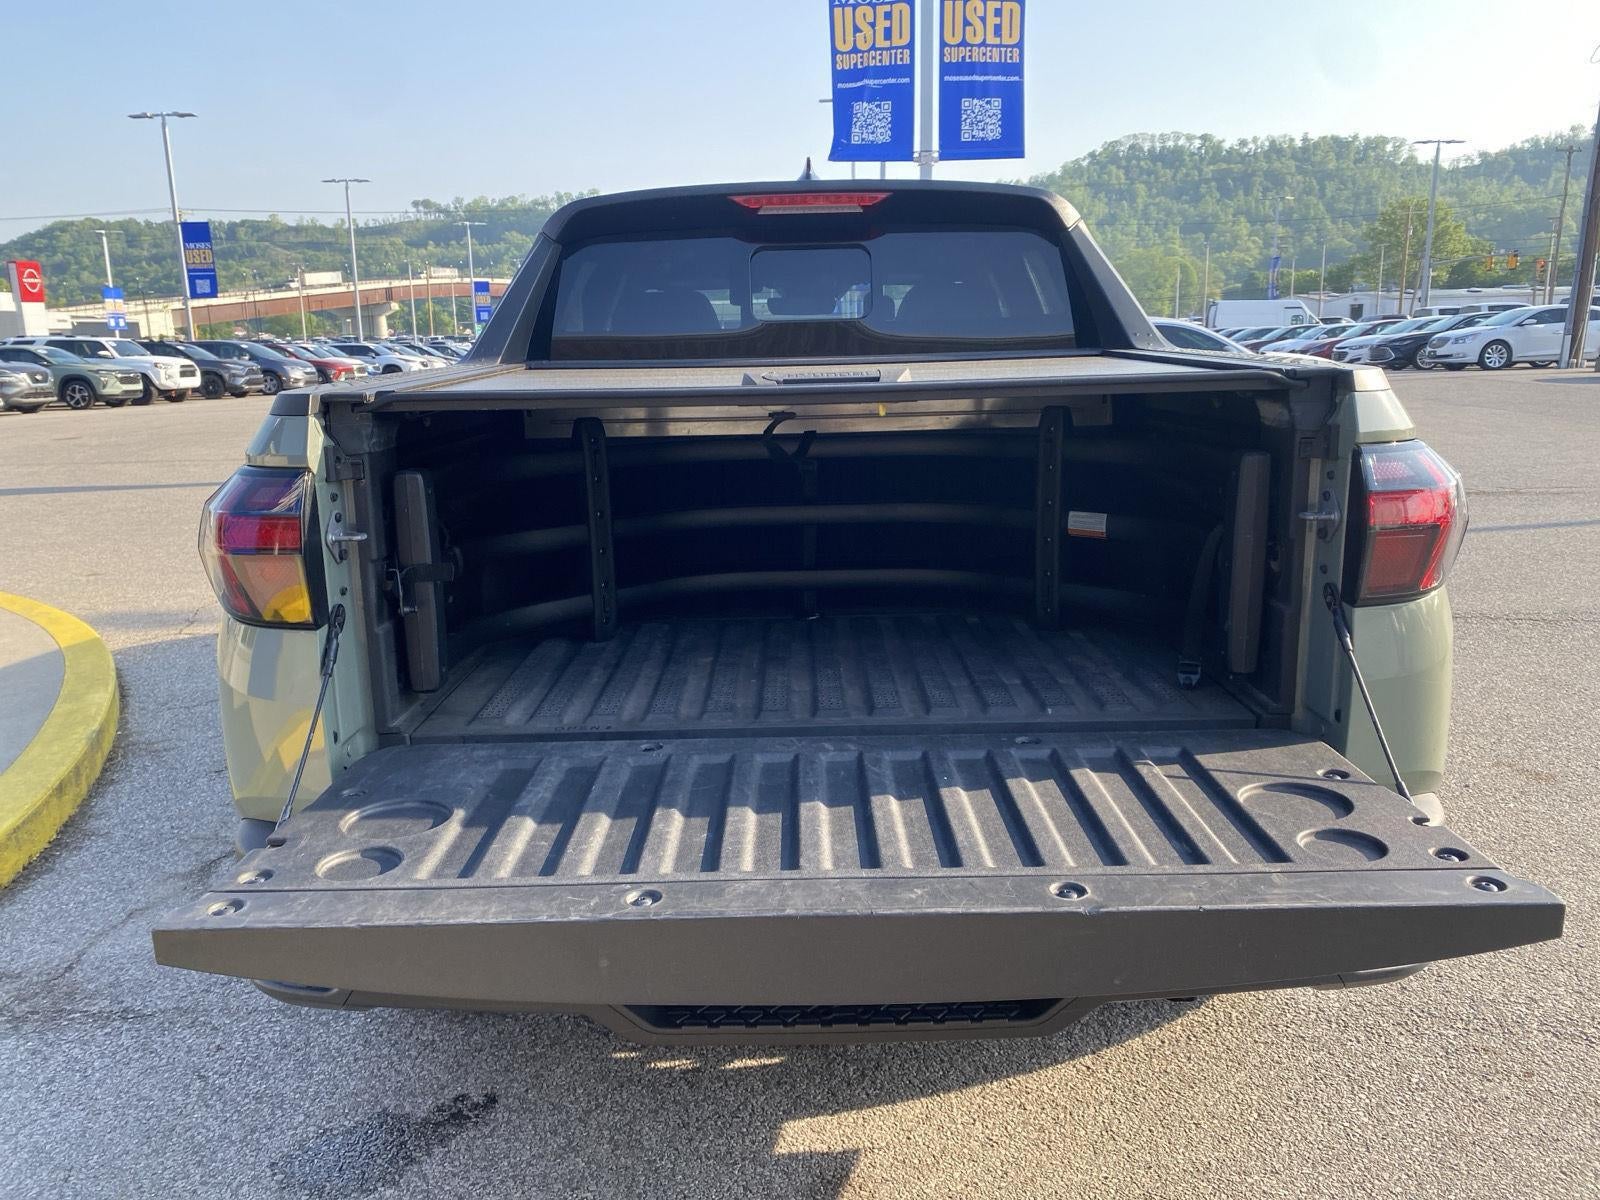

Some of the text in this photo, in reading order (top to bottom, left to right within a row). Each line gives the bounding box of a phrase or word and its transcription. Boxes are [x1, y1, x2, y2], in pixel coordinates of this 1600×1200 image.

[834, 3, 910, 52] USED
[944, 0, 1020, 45] USED
[836, 49, 910, 70] SUPERCENTER
[944, 46, 1020, 63] SUPERCENTER
[185, 250, 213, 264] USED
